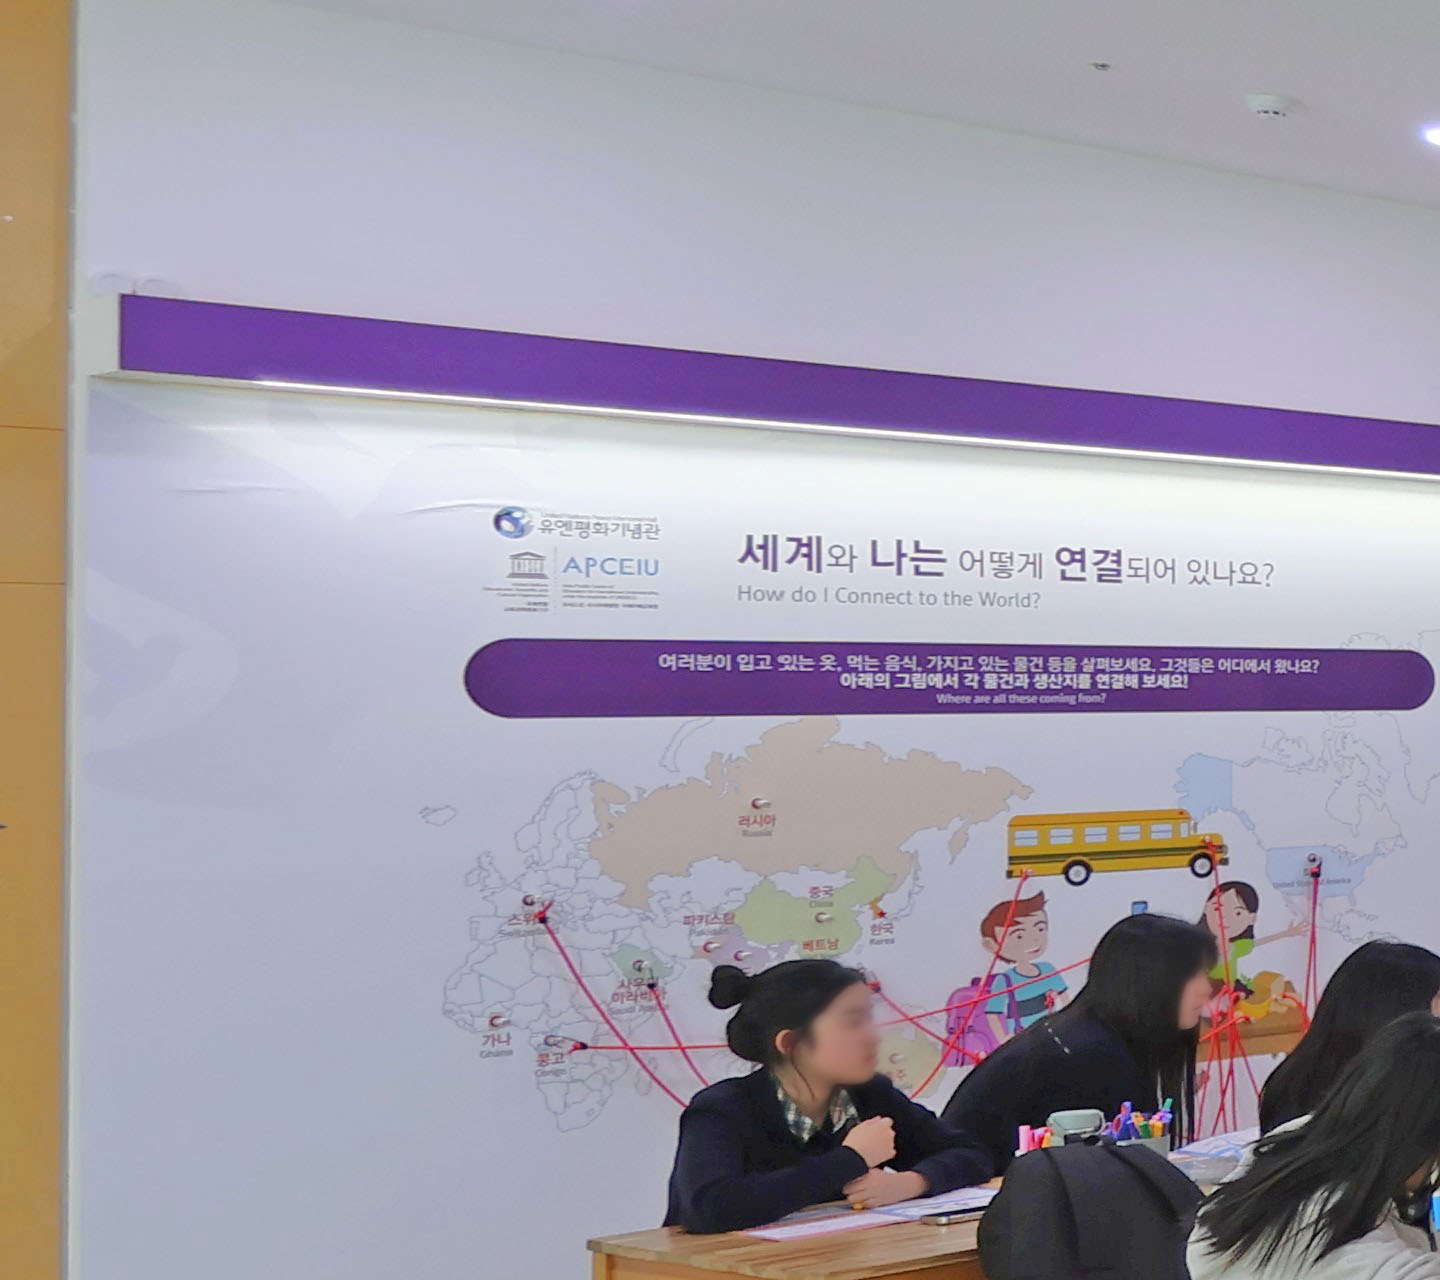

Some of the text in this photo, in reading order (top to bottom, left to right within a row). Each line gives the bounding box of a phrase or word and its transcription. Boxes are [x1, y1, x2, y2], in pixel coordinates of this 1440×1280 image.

[537, 519, 660, 540] 유엔평화기념관
[562, 556, 660, 578] APCEIU
[737, 533, 1274, 588] 세계와 나는 어떻게 연결되어 있나요?
[737, 585, 1041, 609] How do I Connect to the World?
[658, 653, 1320, 674] 여러분이 입고 있는 옷, 먹는 음식, 가지고 있는 물건 등을 그것들은 어디에서 왔나요?
[840, 673, 1189, 690] 아래의 그림에서 각 물건과 생산지를 연결해 보세요!
[936, 693, 1106, 706] Where are all these coming from?
[738, 815, 776, 827] 러시아
[808, 886, 834, 899] 중국
[682, 912, 735, 926] 파키스탄
[870, 923, 894, 936] 한국
[803, 938, 839, 951] 베트남
[482, 1032, 512, 1047] 가나
[535, 1052, 566, 1067] 콩고
